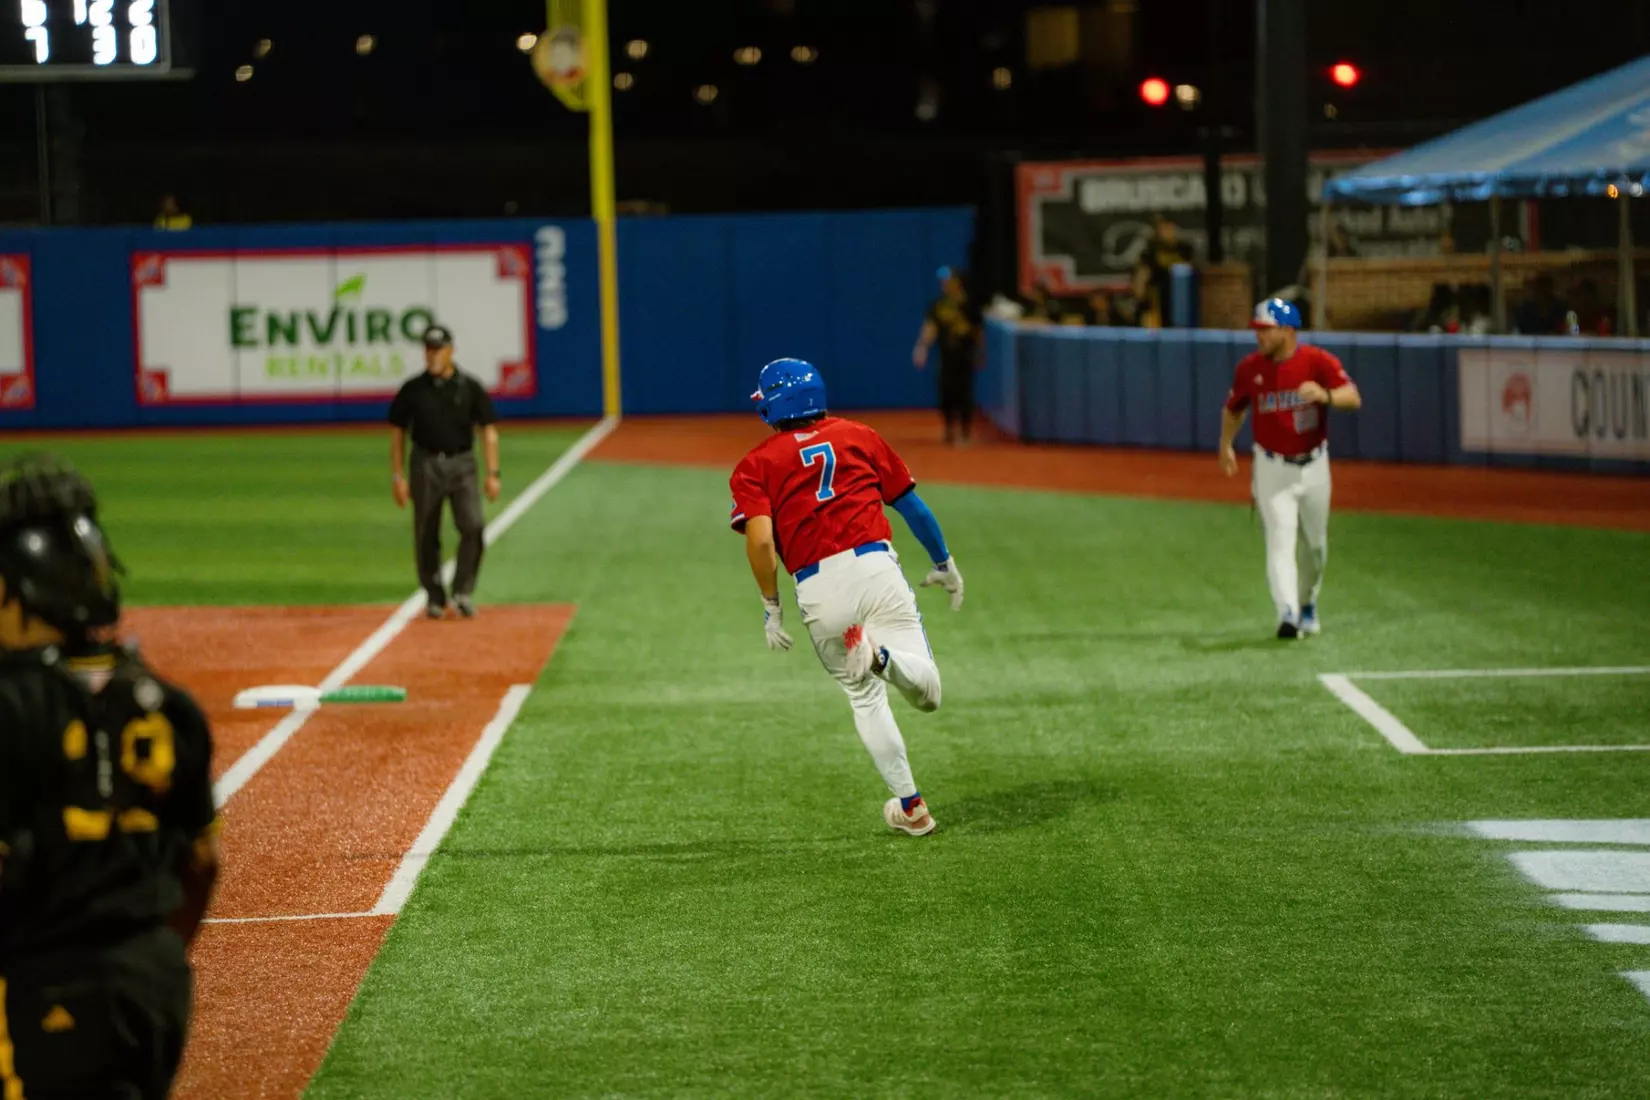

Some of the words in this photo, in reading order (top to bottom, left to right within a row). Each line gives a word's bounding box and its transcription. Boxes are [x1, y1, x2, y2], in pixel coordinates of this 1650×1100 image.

[230, 305, 434, 347] ENVIRO
[265, 353, 405, 379] RENTALS
[799, 441, 836, 502] 7
